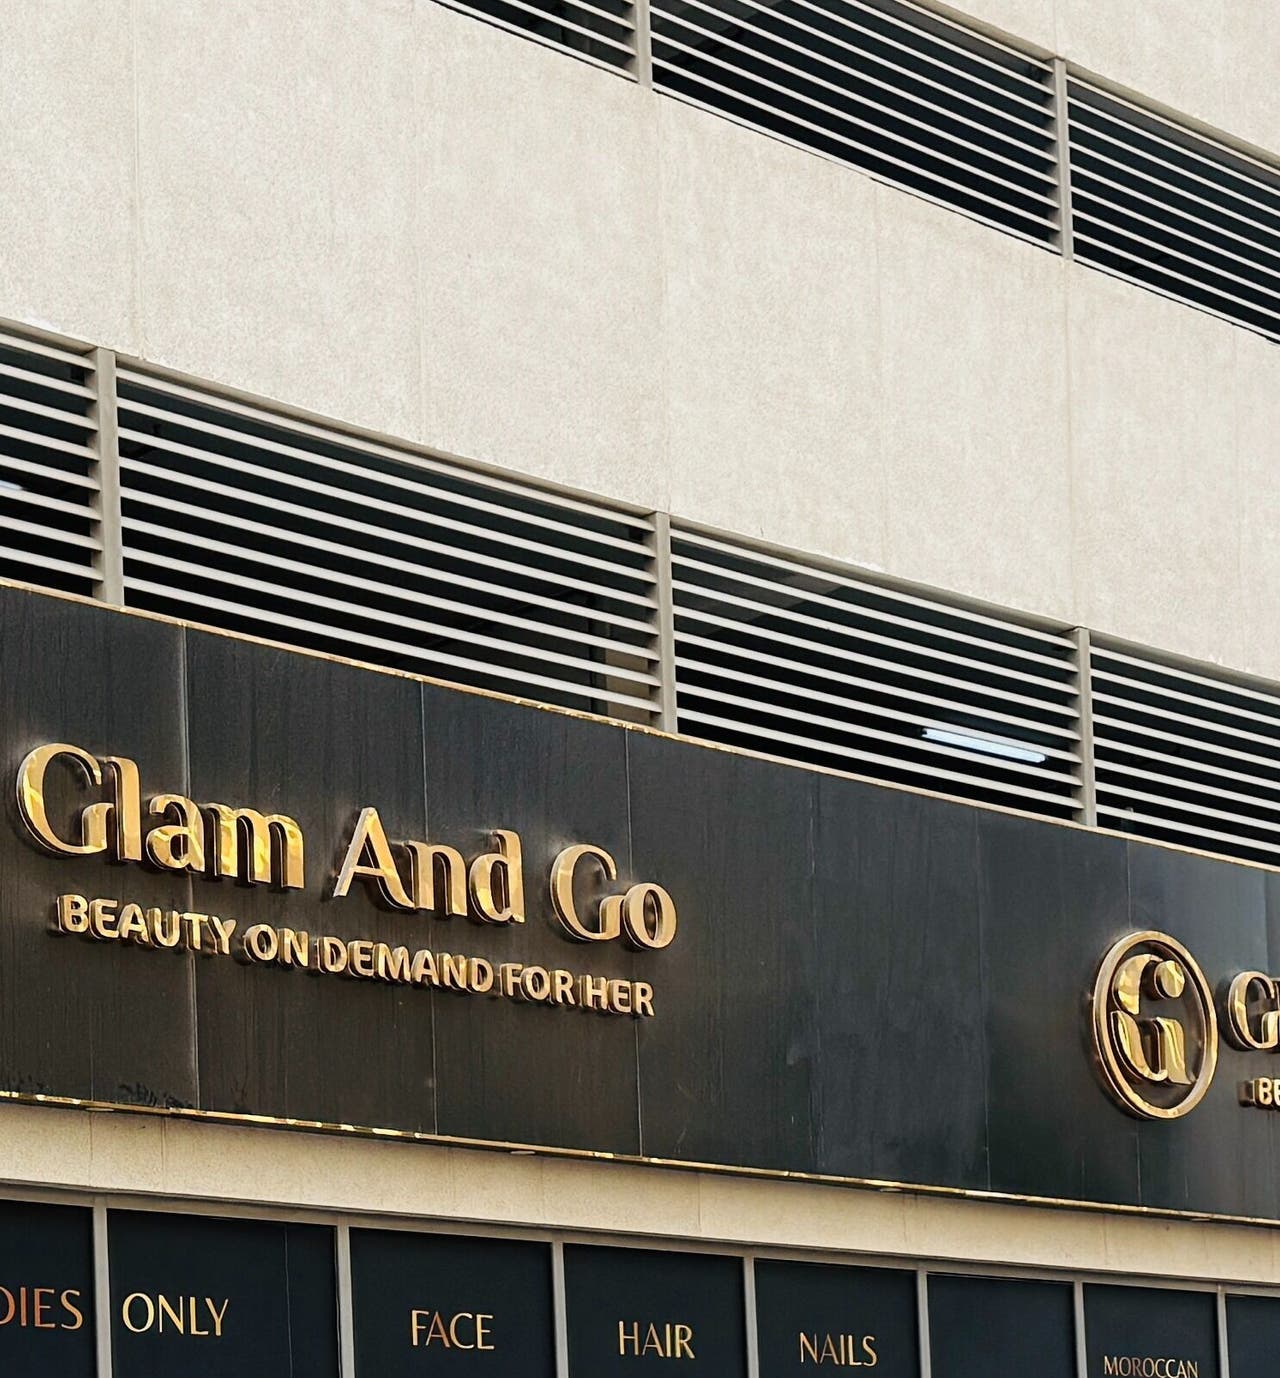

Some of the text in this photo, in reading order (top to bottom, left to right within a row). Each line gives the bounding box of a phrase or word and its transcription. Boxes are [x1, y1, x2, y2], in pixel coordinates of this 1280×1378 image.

[17, 742, 677, 952] Glam And Go
[57, 893, 655, 1017] BEAUTY ON DEMAND FOR HER
[122, 1292, 228, 1337] ONLY
[411, 1309, 495, 1350] FACE
[618, 1320, 696, 1360] HAIR
[799, 1331, 878, 1368] NAILS
